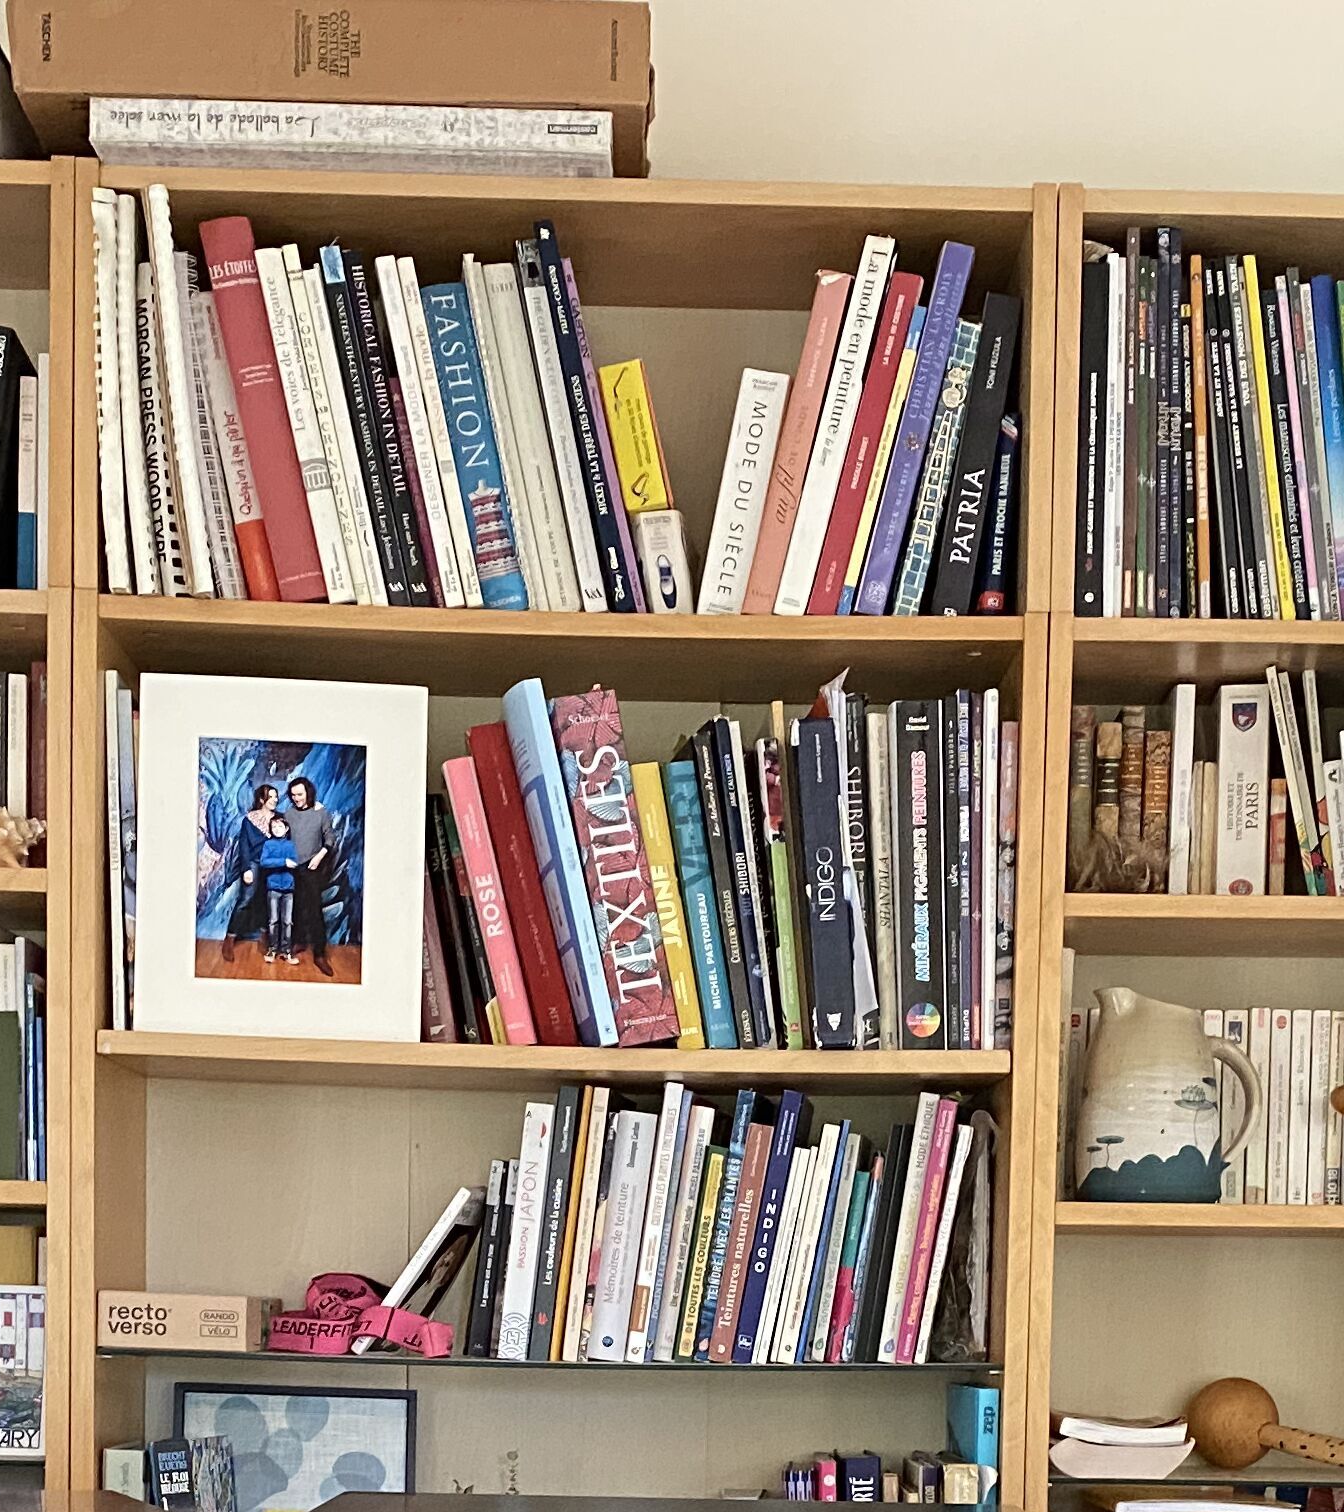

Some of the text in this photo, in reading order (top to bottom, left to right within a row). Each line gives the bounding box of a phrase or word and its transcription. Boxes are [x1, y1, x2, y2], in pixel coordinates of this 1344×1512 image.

[41, 11, 53, 63] TASCHEN
[316, 17, 329, 73] HISTORY
[327, 11, 339, 76] COSTUME
[338, 10, 351, 79] COMPLETE
[350, 29, 361, 58] THE
[1216, 270, 1225, 296] TARDI
[1229, 263, 1241, 293] TARDI
[827, 250, 888, 435] La mode en peinture
[351, 264, 406, 497] HISTORICAL FASHION IN DETAIL
[429, 291, 491, 470] FASHION
[717, 400, 768, 596] MODE DU SIÈCLE
[949, 468, 986, 564] PATRIA
[1228, 567, 1239, 613] casterman
[1246, 568, 1257, 614] casterman
[1258, 560, 1272, 617] casterman
[1244, 782, 1260, 830] PARIS
[575, 745, 663, 1004] TEXTILES
[735, 851, 751, 895] SHIBORI
[816, 847, 836, 922] INDIGO
[878, 856, 893, 929] SHANTALA
[911, 751, 931, 981] MINÉRAUX PIGMENTS PEINTURES
[475, 873, 503, 937] ROSE
[651, 865, 682, 947] JAUNE
[696, 892, 721, 1010] MICHEL PASTOUREAU
[516, 1161, 540, 1269] PASSION JAPON
[549, 1220, 558, 1230] de
[551, 1178, 564, 1209] cuisine
[544, 1231, 558, 1269] couleurs
[601, 1182, 630, 1303] Mémoires de teinture
[707, 1157, 737, 1301] TEINDRE AVEC LES PLANTES
[717, 1188, 755, 1328] Teintures naturelles
[542, 1270, 554, 1285] Les
[684, 1215, 712, 1334] DE TOUTES LES COULEURS
[107, 1319, 167, 1336] verso
[108, 1303, 168, 1321] recto
[983, 1407, 996, 1435] zep
